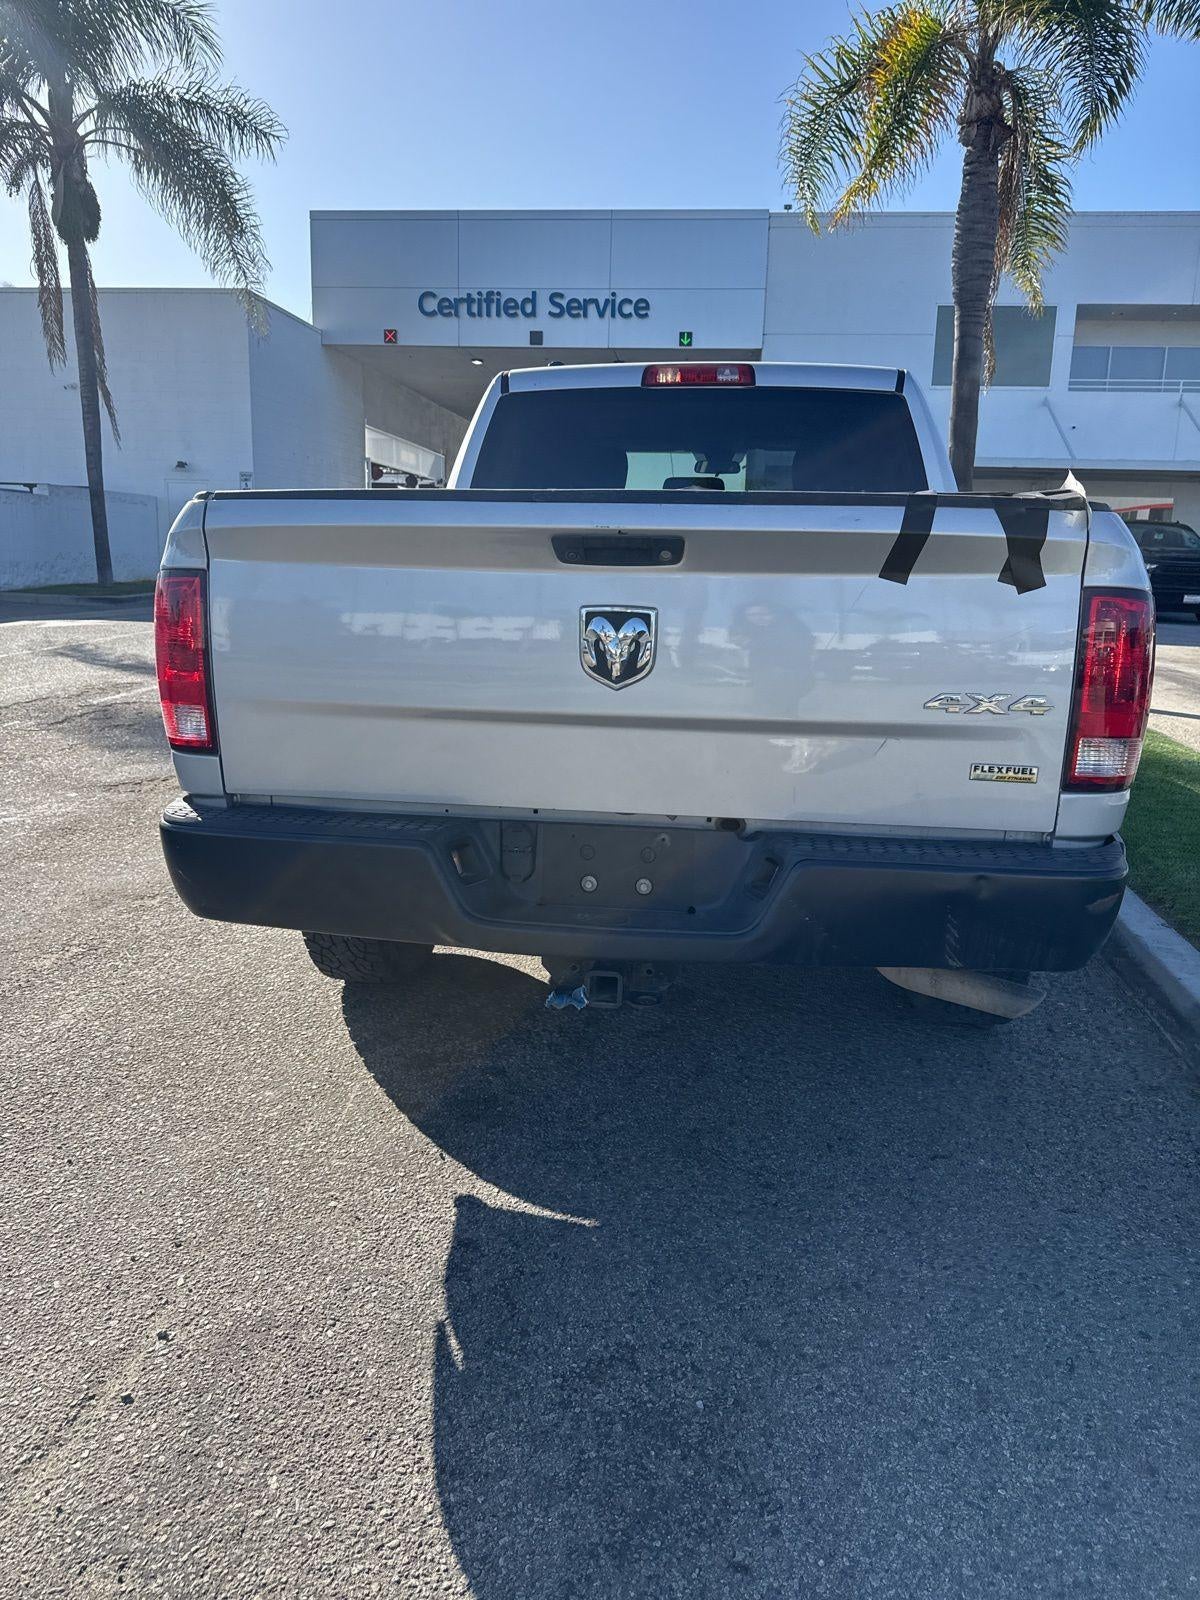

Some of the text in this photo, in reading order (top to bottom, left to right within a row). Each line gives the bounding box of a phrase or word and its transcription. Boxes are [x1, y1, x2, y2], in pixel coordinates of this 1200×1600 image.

[418, 290, 650, 319] Certified Service
[973, 765, 1036, 776] FLEXFUEL
